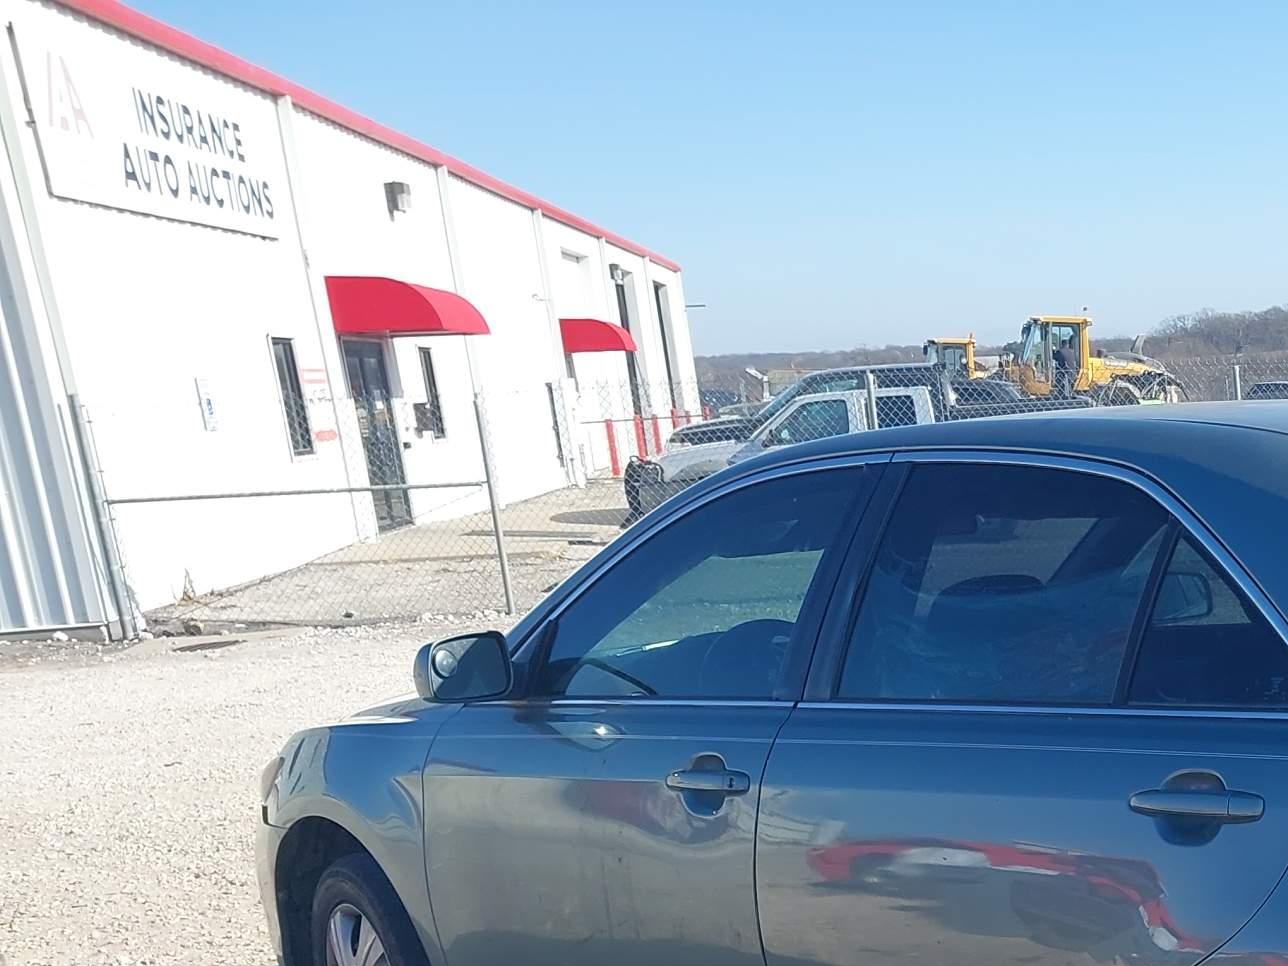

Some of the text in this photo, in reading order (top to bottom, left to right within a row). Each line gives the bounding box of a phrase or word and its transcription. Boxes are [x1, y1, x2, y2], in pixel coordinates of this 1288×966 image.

[131, 86, 246, 163] INSURANCE
[122, 142, 275, 220] AUTO AUCTIONS
